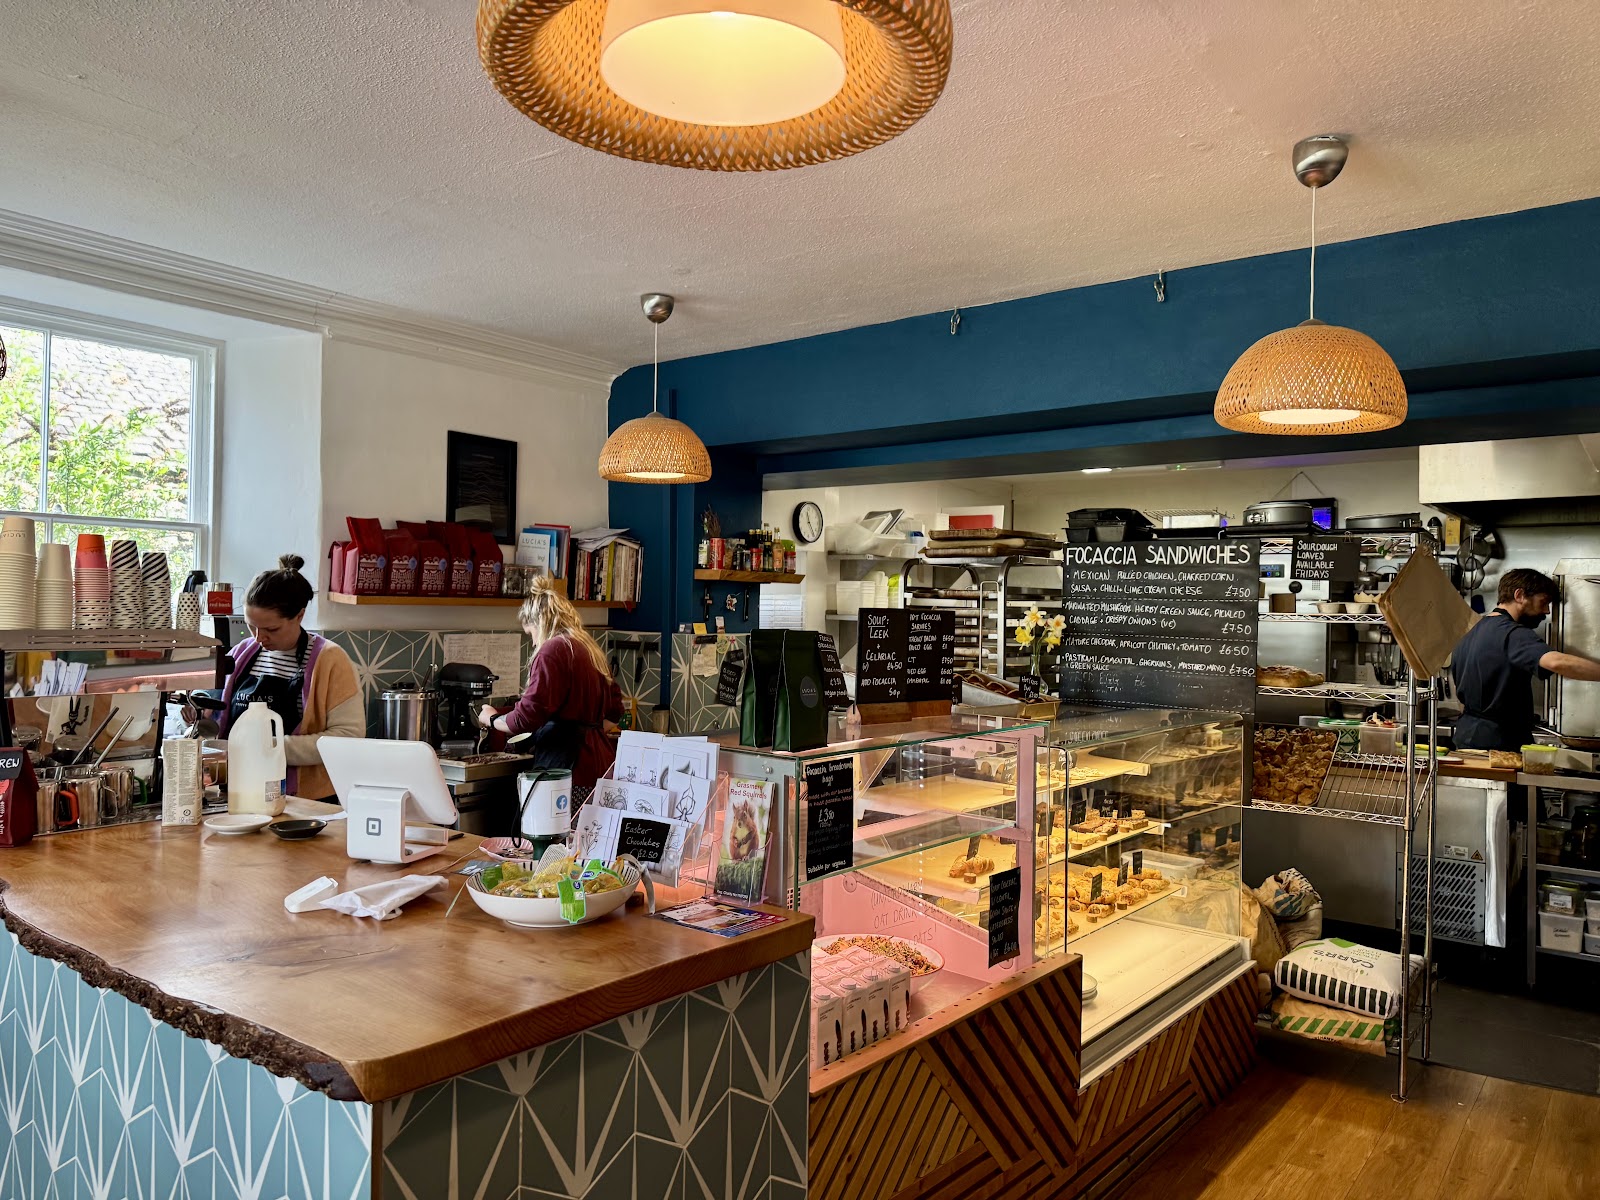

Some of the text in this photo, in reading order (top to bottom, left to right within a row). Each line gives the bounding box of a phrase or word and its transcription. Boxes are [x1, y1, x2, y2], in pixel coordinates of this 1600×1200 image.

[1296, 540, 1338, 551] SOURDOUGH
[1066, 544, 1251, 565] FOCACCIA SANDWICHES
[1297, 552, 1325, 560] LOAVES
[1296, 561, 1335, 569] AVAILABLE
[1073, 569, 1111, 580] MEXICAN
[1117, 570, 1142, 580] PULLED
[1178, 572, 1210, 581] CHARRED
[1295, 569, 1330, 578] FRIDAYS
[1071, 583, 1092, 594] SALSA
[1124, 584, 1143, 595] LIME
[1144, 586, 1166, 595] CREAM
[1169, 586, 1203, 595] CHEESE
[1135, 605, 1158, 614] HERBY
[1160, 606, 1186, 615] GREEN
[1214, 609, 1246, 619] PICKLED
[867, 614, 890, 626] SOUP:
[1069, 615, 1098, 624] CABBAGE
[1105, 615, 1128, 624] CRISPY
[1128, 616, 1157, 626] ONIONS
[869, 626, 889, 639] LEEK
[1066, 637, 1090, 646] MATURE
[1120, 641, 1147, 649] APRICOT
[1180, 643, 1212, 654] TOMATO
[1070, 662, 1091, 670] GREEN
[236, 693, 274, 703] LUCIA'S
[737, 782, 763, 790] Grasmere
[742, 790, 767, 799] Squirrels
[625, 822, 652, 834] Easter
[626, 837, 660, 848] Chocolates
